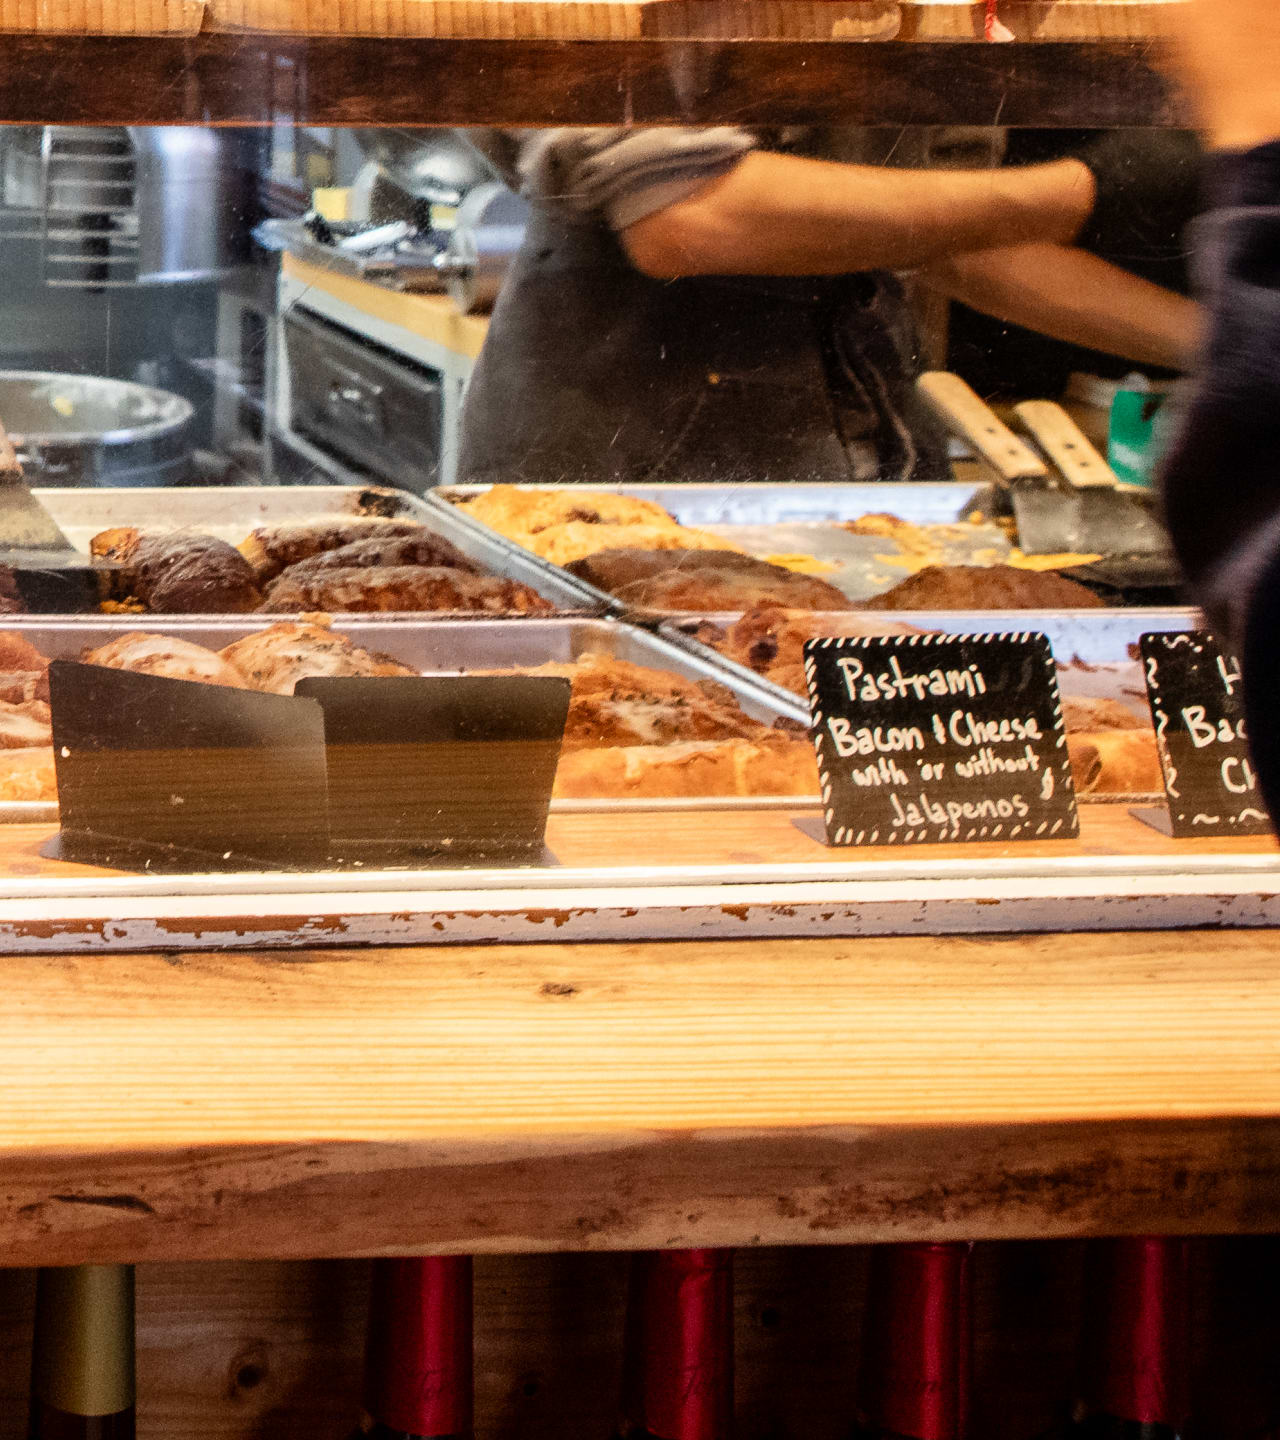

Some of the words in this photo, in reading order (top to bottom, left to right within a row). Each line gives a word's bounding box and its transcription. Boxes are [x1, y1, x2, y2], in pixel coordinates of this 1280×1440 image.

[836, 655, 987, 702] Pastrami
[827, 716, 925, 757] Bacon
[948, 709, 1043, 747] Cheese
[851, 756, 909, 786] with
[955, 744, 1040, 778] without
[890, 792, 1030, 829] Jalapenos
